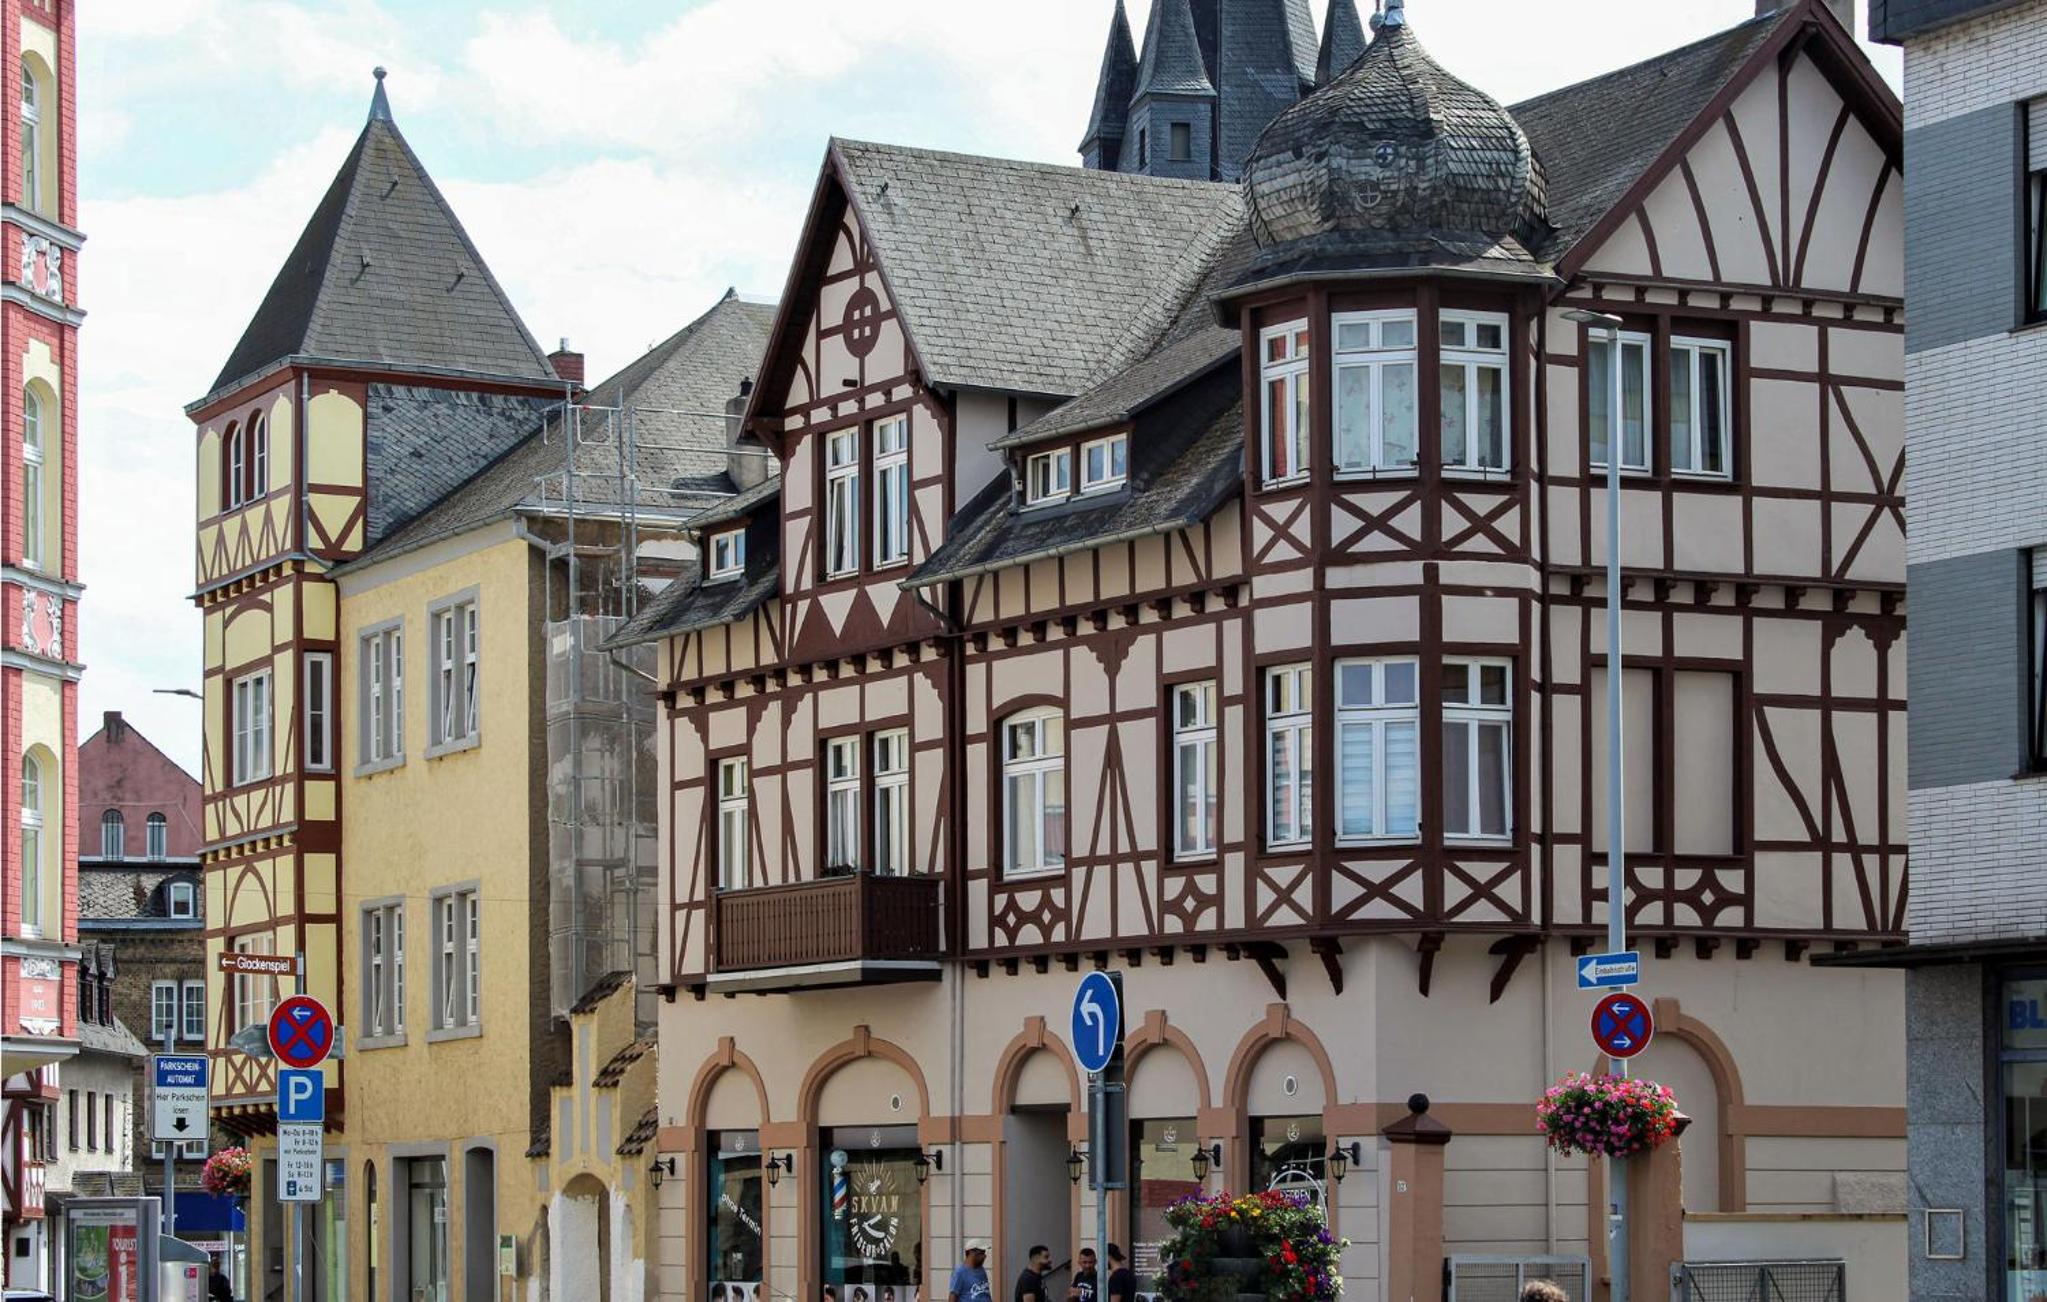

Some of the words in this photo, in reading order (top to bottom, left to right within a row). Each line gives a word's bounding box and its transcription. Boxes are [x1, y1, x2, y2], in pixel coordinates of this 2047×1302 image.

[237, 956, 290, 974] Glockenspiel
[167, 1075, 196, 1084] AUTOMAT
[156, 1092, 169, 1101] Hier
[171, 1092, 206, 1102] Parkschein
[288, 1076, 313, 1114] P
[850, 1218, 877, 1258] FRISEUR
[880, 1217, 899, 1255] SALON
